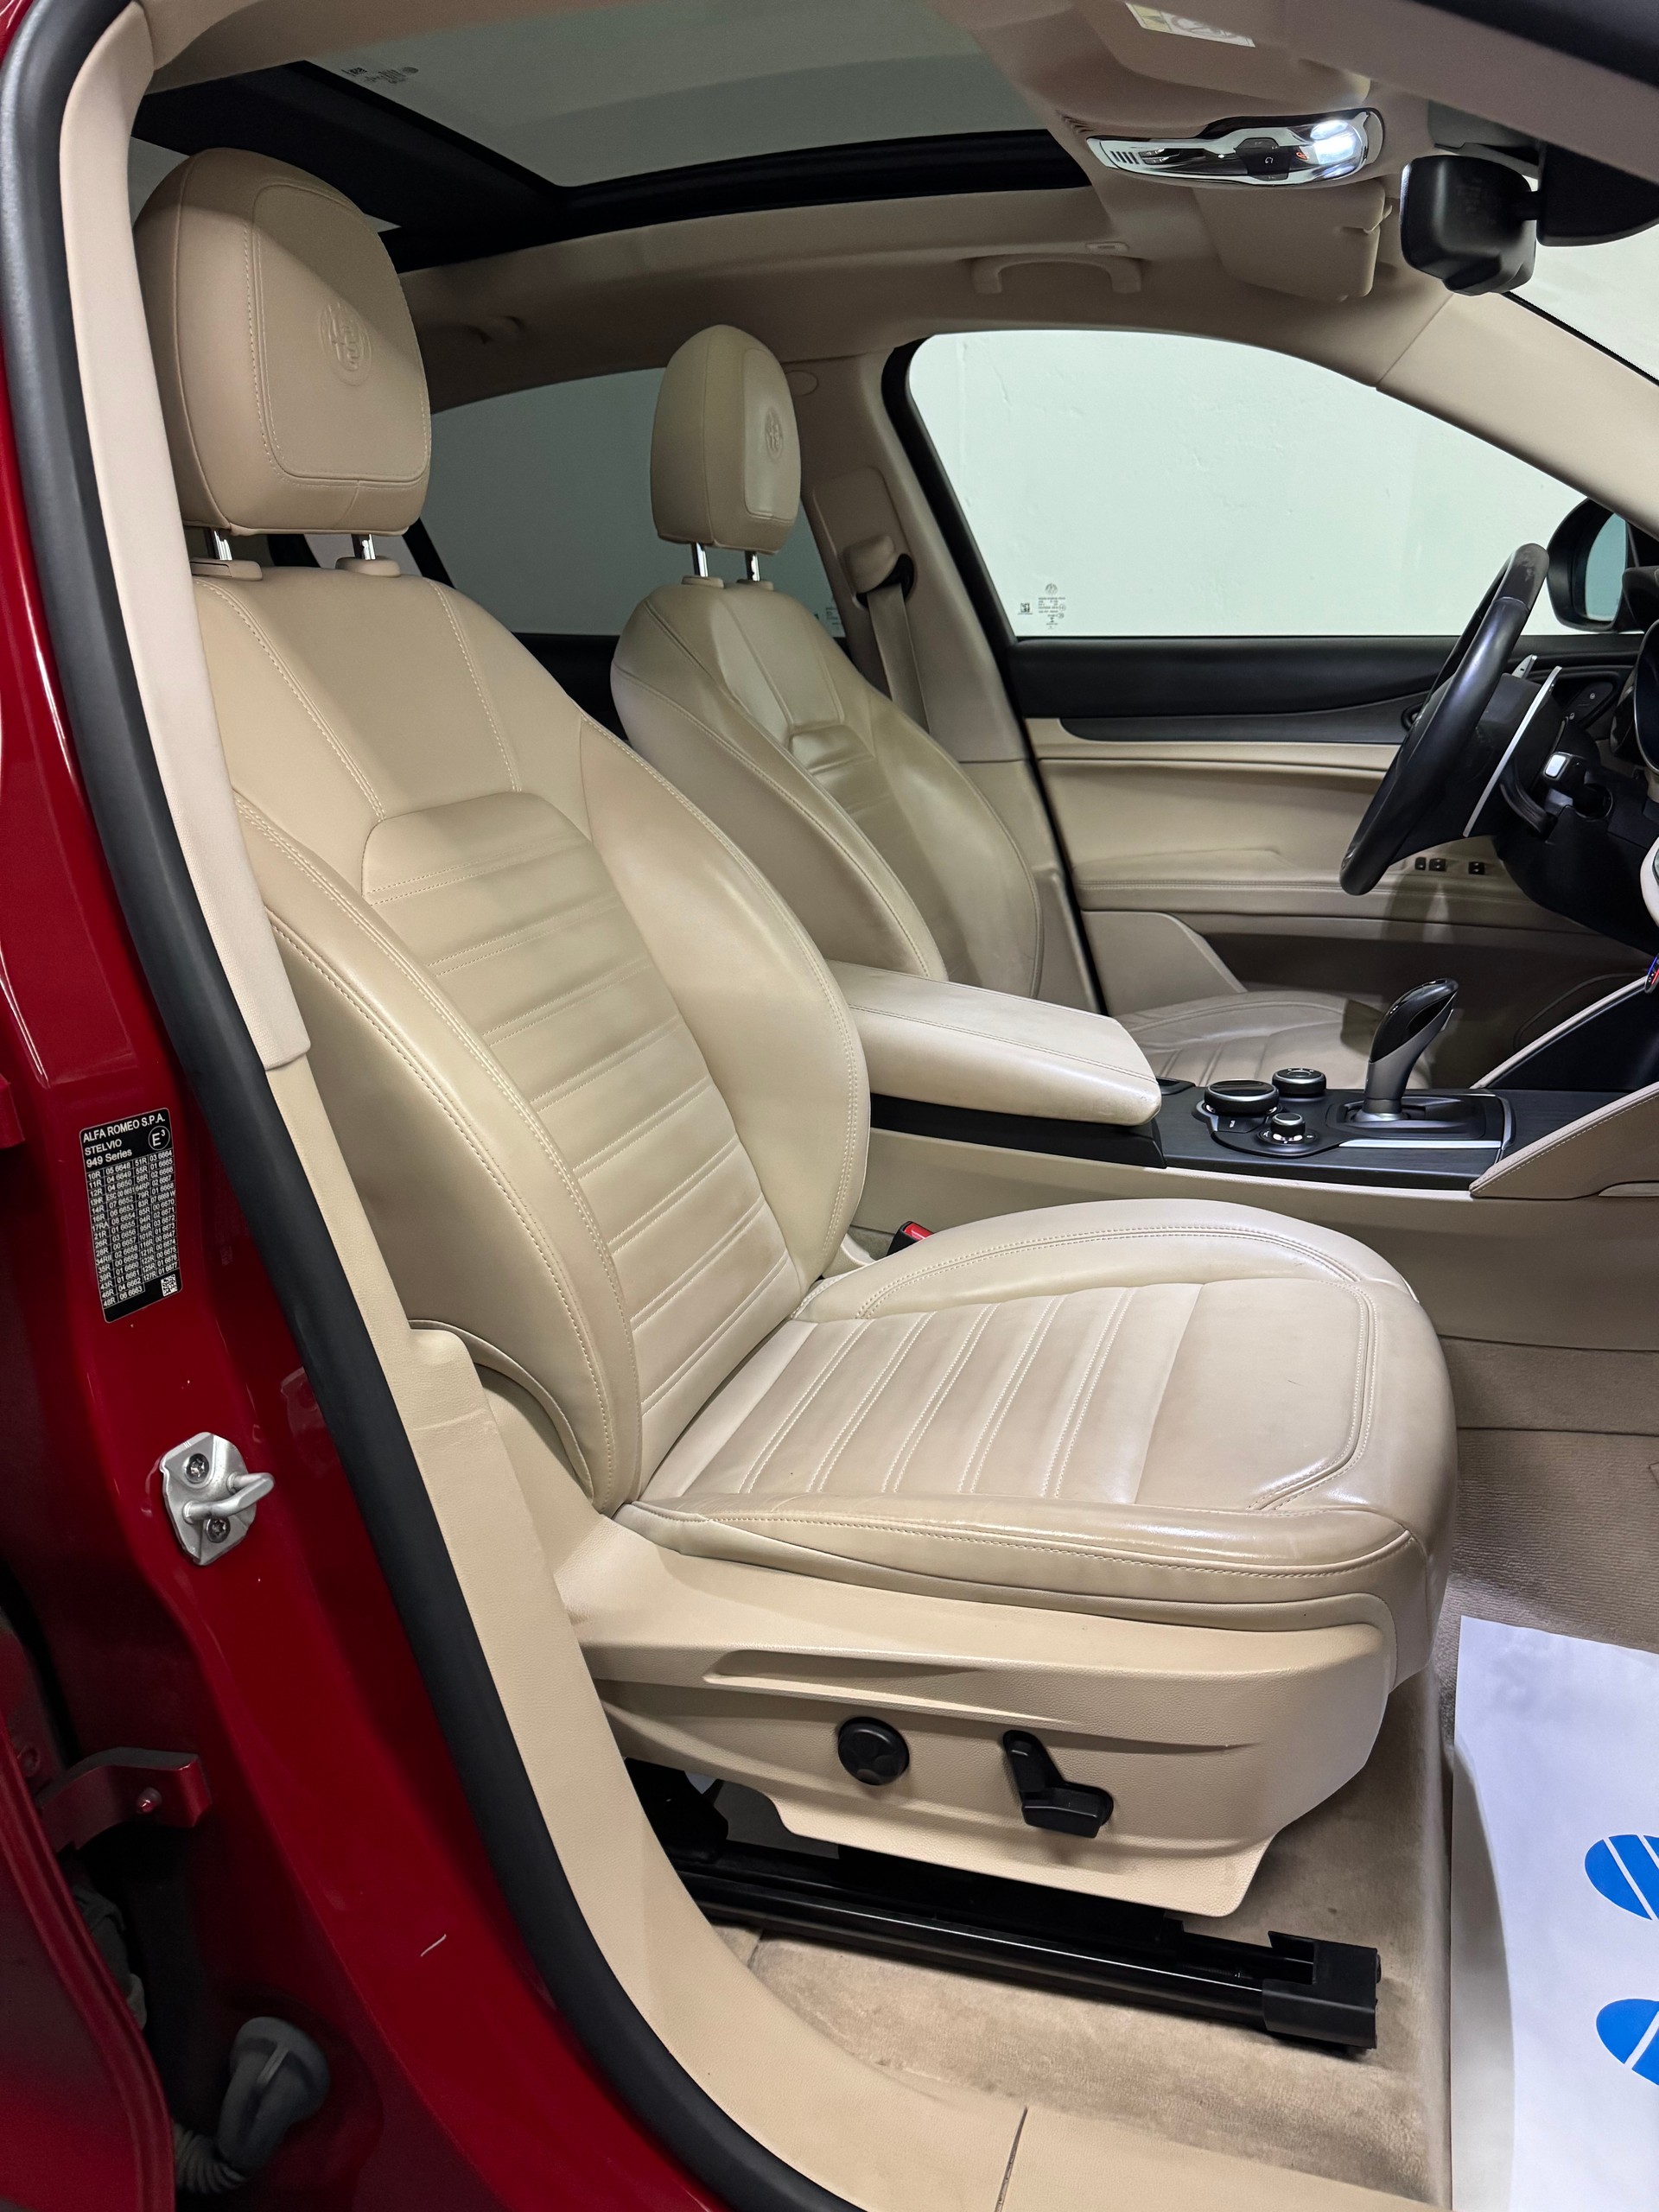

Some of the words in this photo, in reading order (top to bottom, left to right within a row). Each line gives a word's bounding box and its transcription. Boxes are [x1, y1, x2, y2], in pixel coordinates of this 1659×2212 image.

[83, 1128, 106, 1142] ALFA
[107, 1120, 140, 1136] ROMEO
[142, 1113, 165, 1127] S.P.A.
[85, 1139, 122, 1156] STELVIO
[86, 1156, 104, 1168] 949
[105, 1147, 132, 1163] Series
[88, 1172, 100, 1180] 10R
[89, 1180, 101, 1189] 11R
[91, 1189, 102, 1198] 12R
[92, 1205, 104, 1214] 14R
[92, 1222, 109, 1232] 17RA
[139, 1207, 150, 1216] 85R
[93, 1214, 105, 1223] 16R
[94, 1231, 106, 1240] 21R
[140, 1231, 152, 1241] 101R
[141, 1239, 153, 1249] 116R
[142, 1248, 154, 1256] 121R
[143, 1255, 154, 1264] 122R
[144, 1272, 156, 1281] 127R
